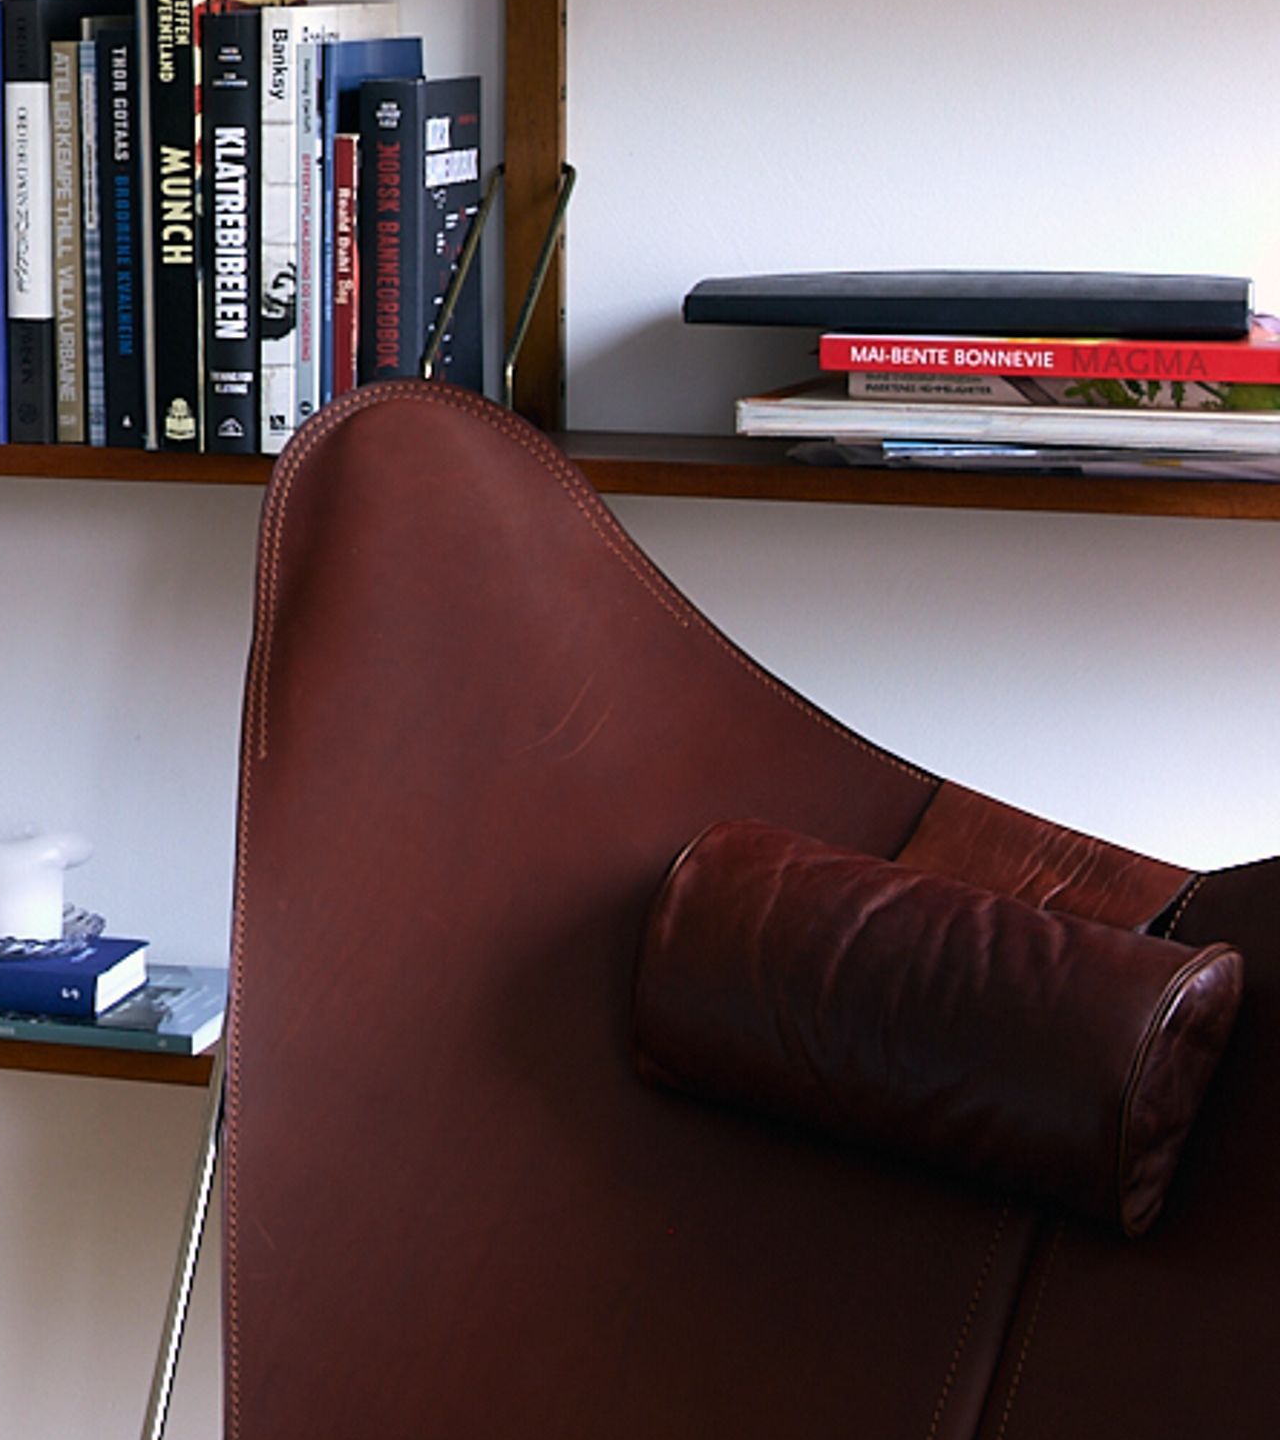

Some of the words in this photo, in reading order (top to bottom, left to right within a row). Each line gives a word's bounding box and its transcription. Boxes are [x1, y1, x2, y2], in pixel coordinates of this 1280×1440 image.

[53, 52, 72, 131] ATELIER
[111, 46, 128, 92] THOR
[268, 28, 289, 101] Banksy
[112, 98, 129, 162] GOTAAS
[54, 132, 72, 199] KEMPE
[375, 141, 401, 213] NORSK
[56, 201, 75, 256] THILL
[113, 175, 132, 266] BRØDRENE
[159, 145, 193, 266] MUNCH
[213, 127, 247, 340] KLATREBIBELEN
[336, 187, 351, 233] Roald
[336, 237, 351, 273] Dahl
[56, 265, 75, 320] VILLA
[116, 271, 133, 355] KVALHEIM
[333, 279, 354, 306] Boy
[375, 221, 400, 369] BANNEORDBOK
[59, 324, 77, 403] URBAINE
[849, 345, 949, 365] MAI-BENTE
[953, 347, 1054, 369] BONNEVIE
[1071, 347, 1208, 378] MAGMA
